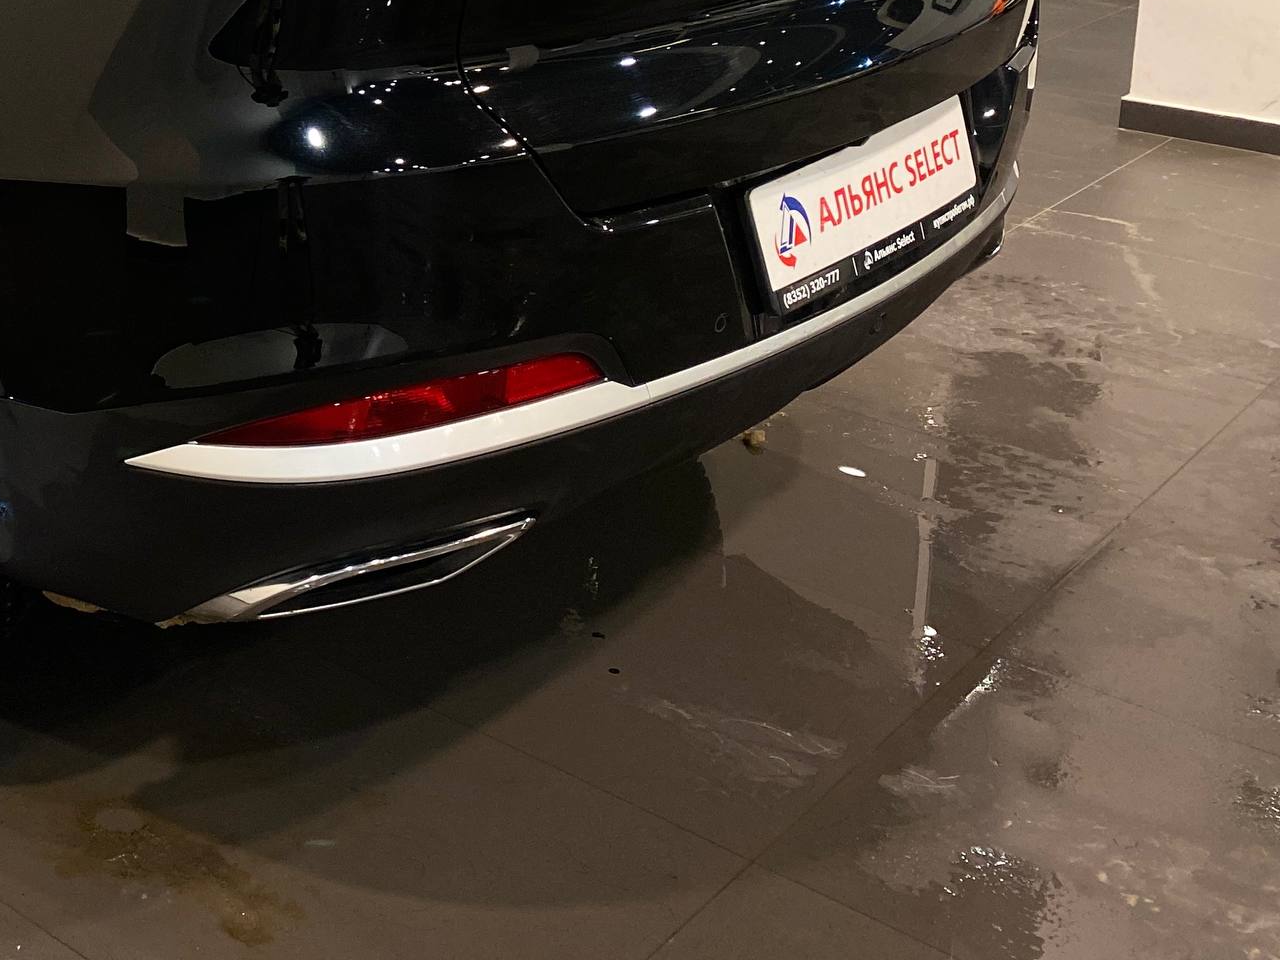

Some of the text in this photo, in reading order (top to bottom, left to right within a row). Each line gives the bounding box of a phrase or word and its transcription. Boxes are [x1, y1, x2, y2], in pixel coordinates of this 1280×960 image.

[819, 129, 960, 232] АЛЬЯНС SELECT
[897, 230, 916, 249] Select
[783, 268, 840, 309] (8352) 320-777
